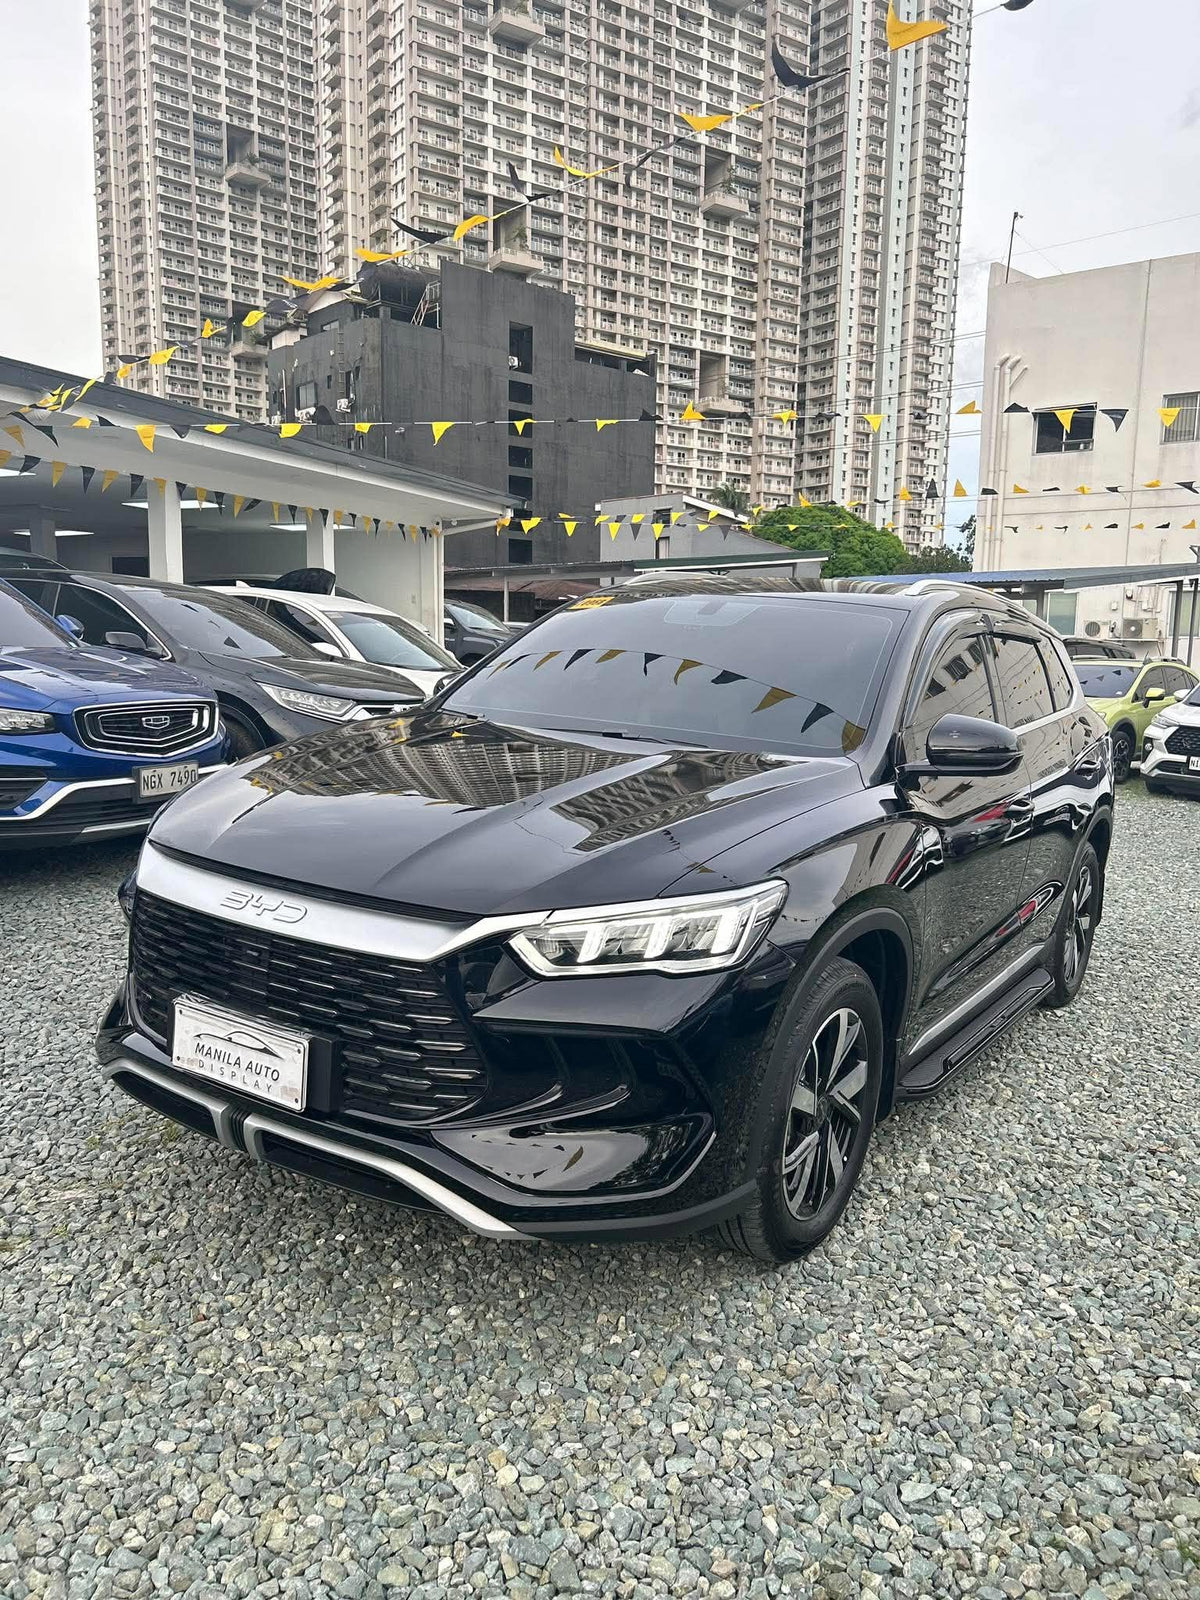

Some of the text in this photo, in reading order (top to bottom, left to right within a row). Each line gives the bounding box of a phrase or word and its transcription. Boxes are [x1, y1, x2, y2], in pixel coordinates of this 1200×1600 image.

[143, 769, 196, 790] NGX 7490
[220, 889, 308, 924] BYD
[195, 1042, 241, 1068] MANILA
[245, 1061, 280, 1082] AUTO
[198, 1059, 272, 1093] DISPLAY
